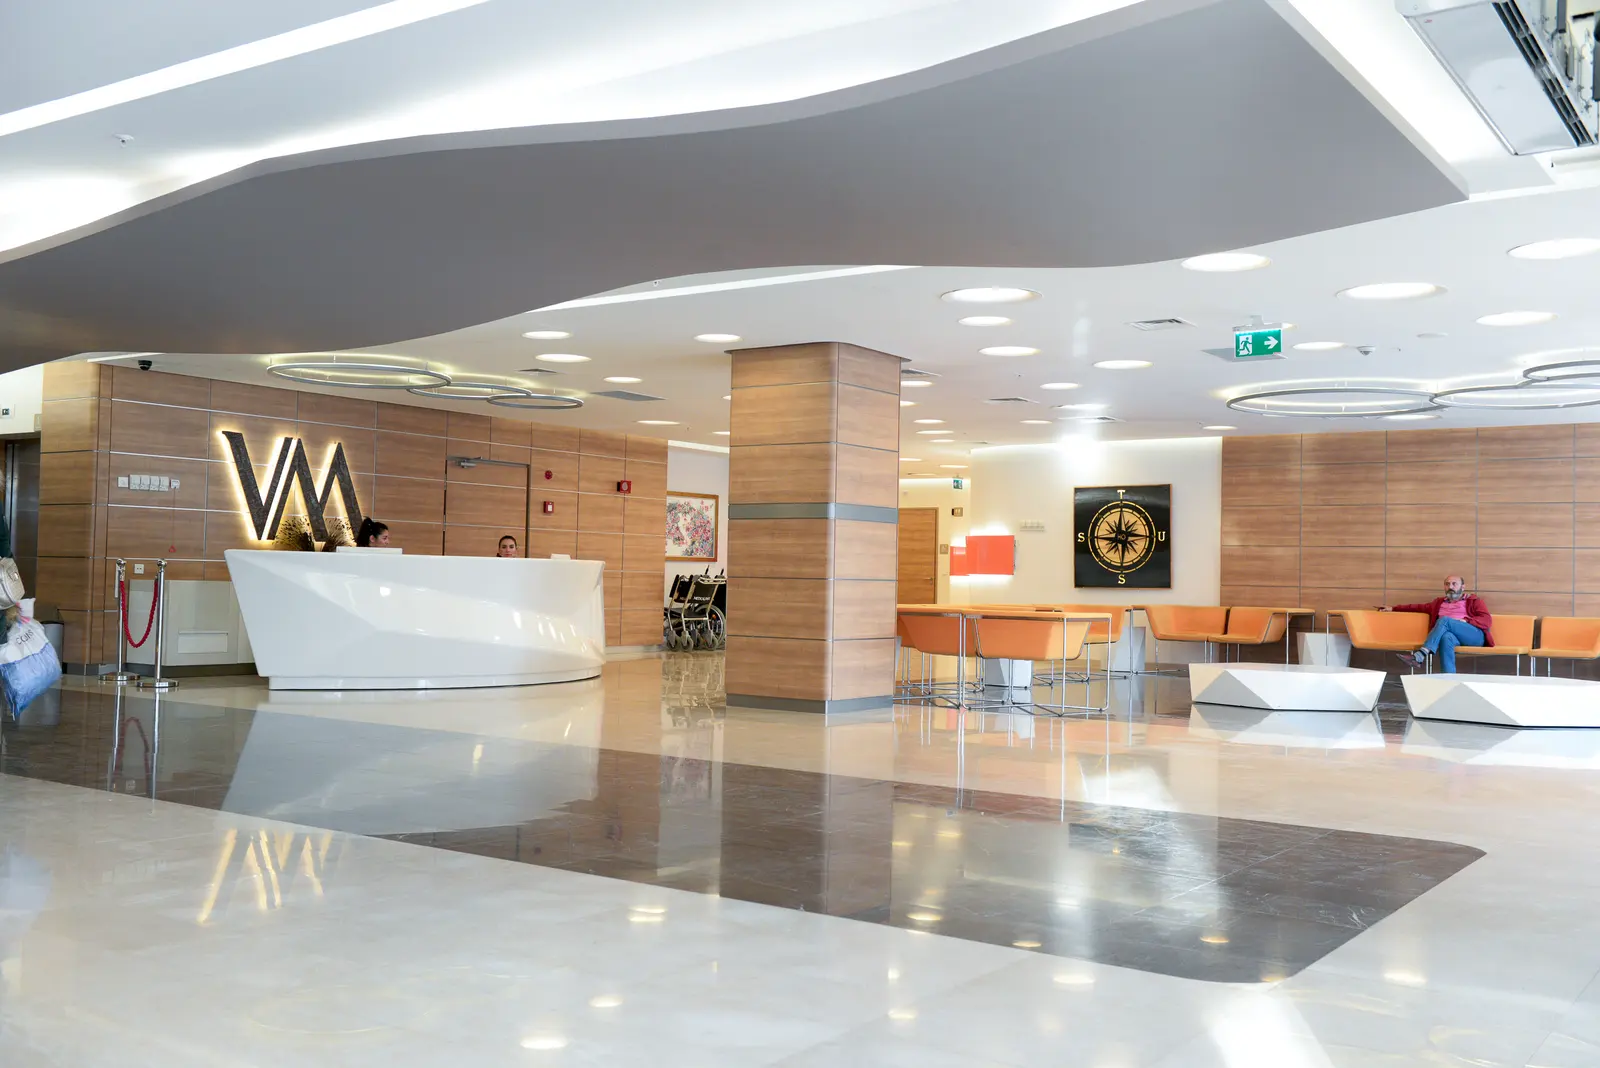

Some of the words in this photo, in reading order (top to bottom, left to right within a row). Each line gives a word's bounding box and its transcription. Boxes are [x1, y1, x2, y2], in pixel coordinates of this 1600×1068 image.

[1117, 489, 1126, 500] T
[1077, 532, 1085, 543] S
[1158, 531, 1166, 542] U
[1117, 574, 1126, 584] S
